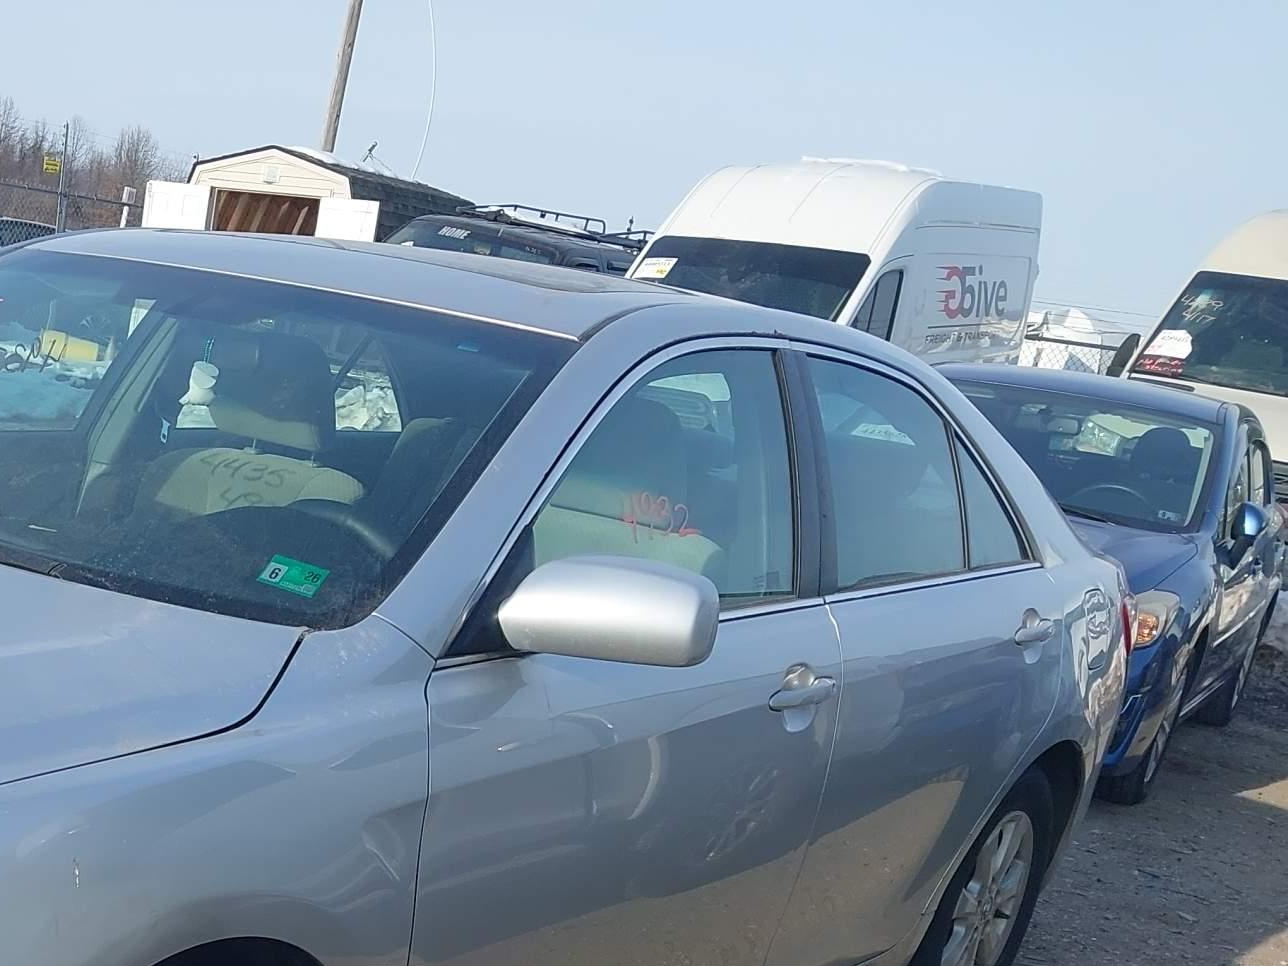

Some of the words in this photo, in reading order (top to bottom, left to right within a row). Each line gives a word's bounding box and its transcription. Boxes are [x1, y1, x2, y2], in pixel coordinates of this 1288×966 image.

[438, 225, 472, 240] HOME
[269, 567, 281, 580] 6
[304, 571, 322, 584] 26
